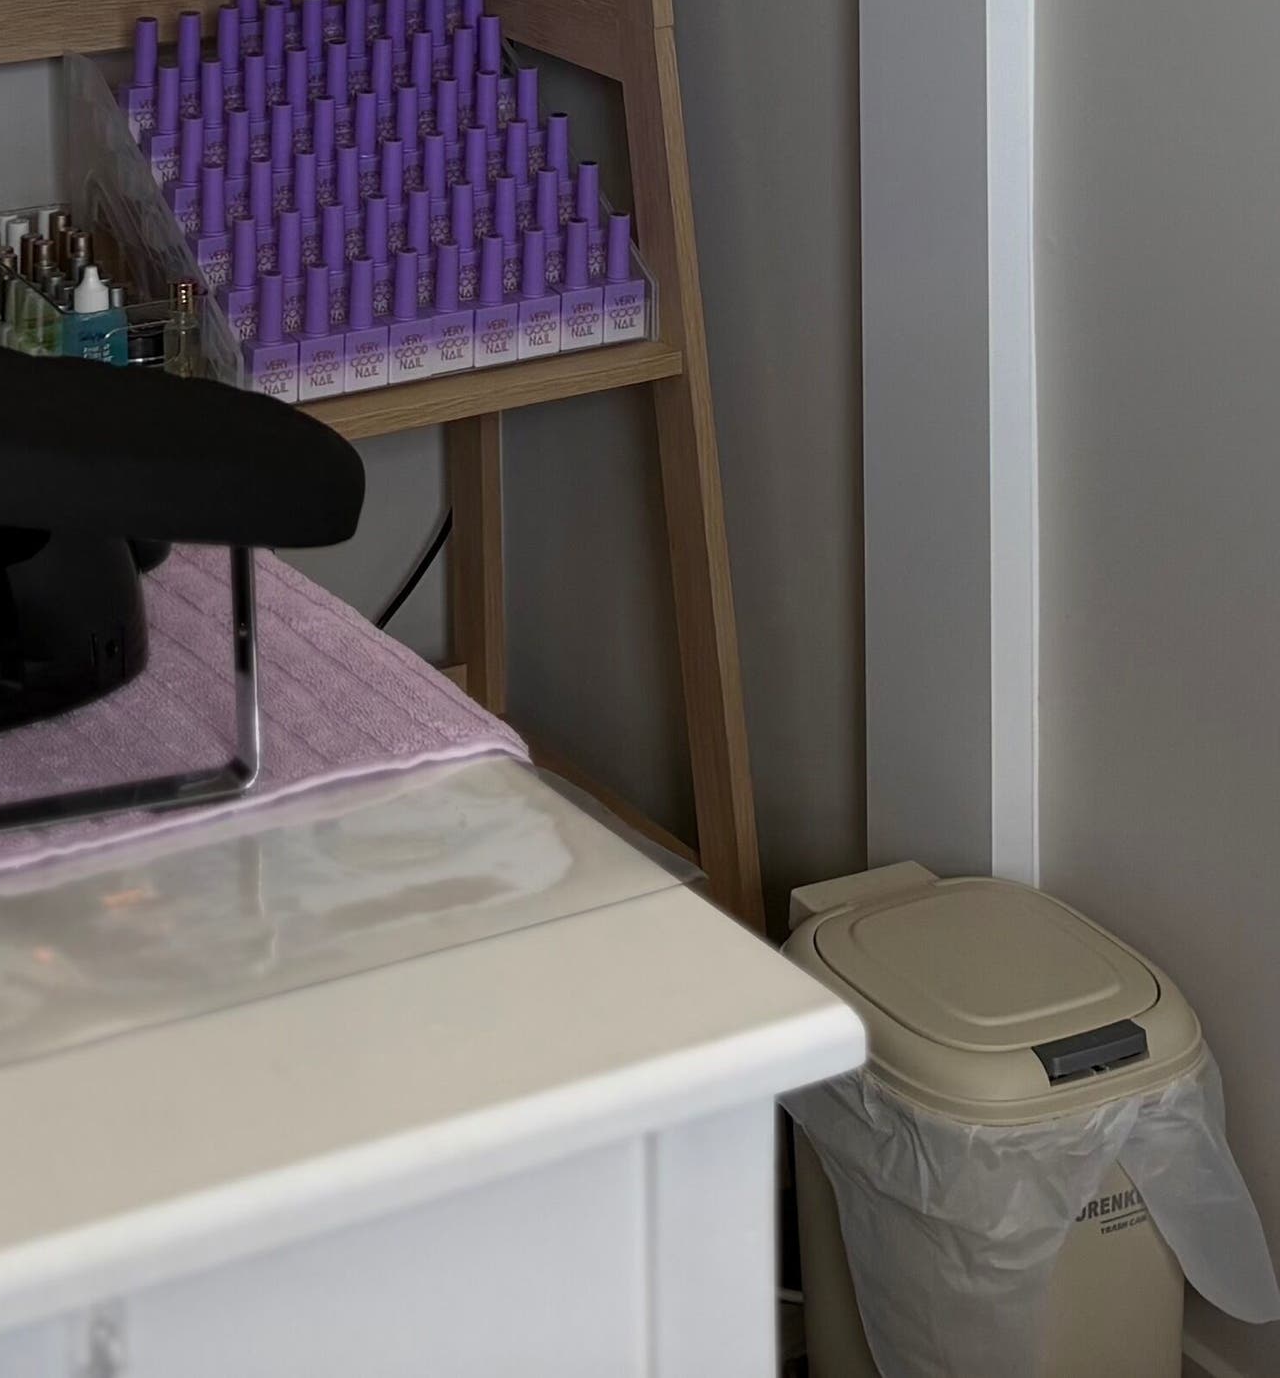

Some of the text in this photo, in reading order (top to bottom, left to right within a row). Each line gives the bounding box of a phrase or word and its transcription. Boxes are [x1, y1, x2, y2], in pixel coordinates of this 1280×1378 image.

[614, 294, 638, 306] VERY
[572, 302, 594, 314] VERY
[529, 310, 552, 323] VERY
[487, 318, 509, 331] VERY
[441, 325, 466, 337] VERY
[401, 333, 424, 345] VERY
[356, 342, 379, 354] VERY
[313, 350, 336, 362] VERY
